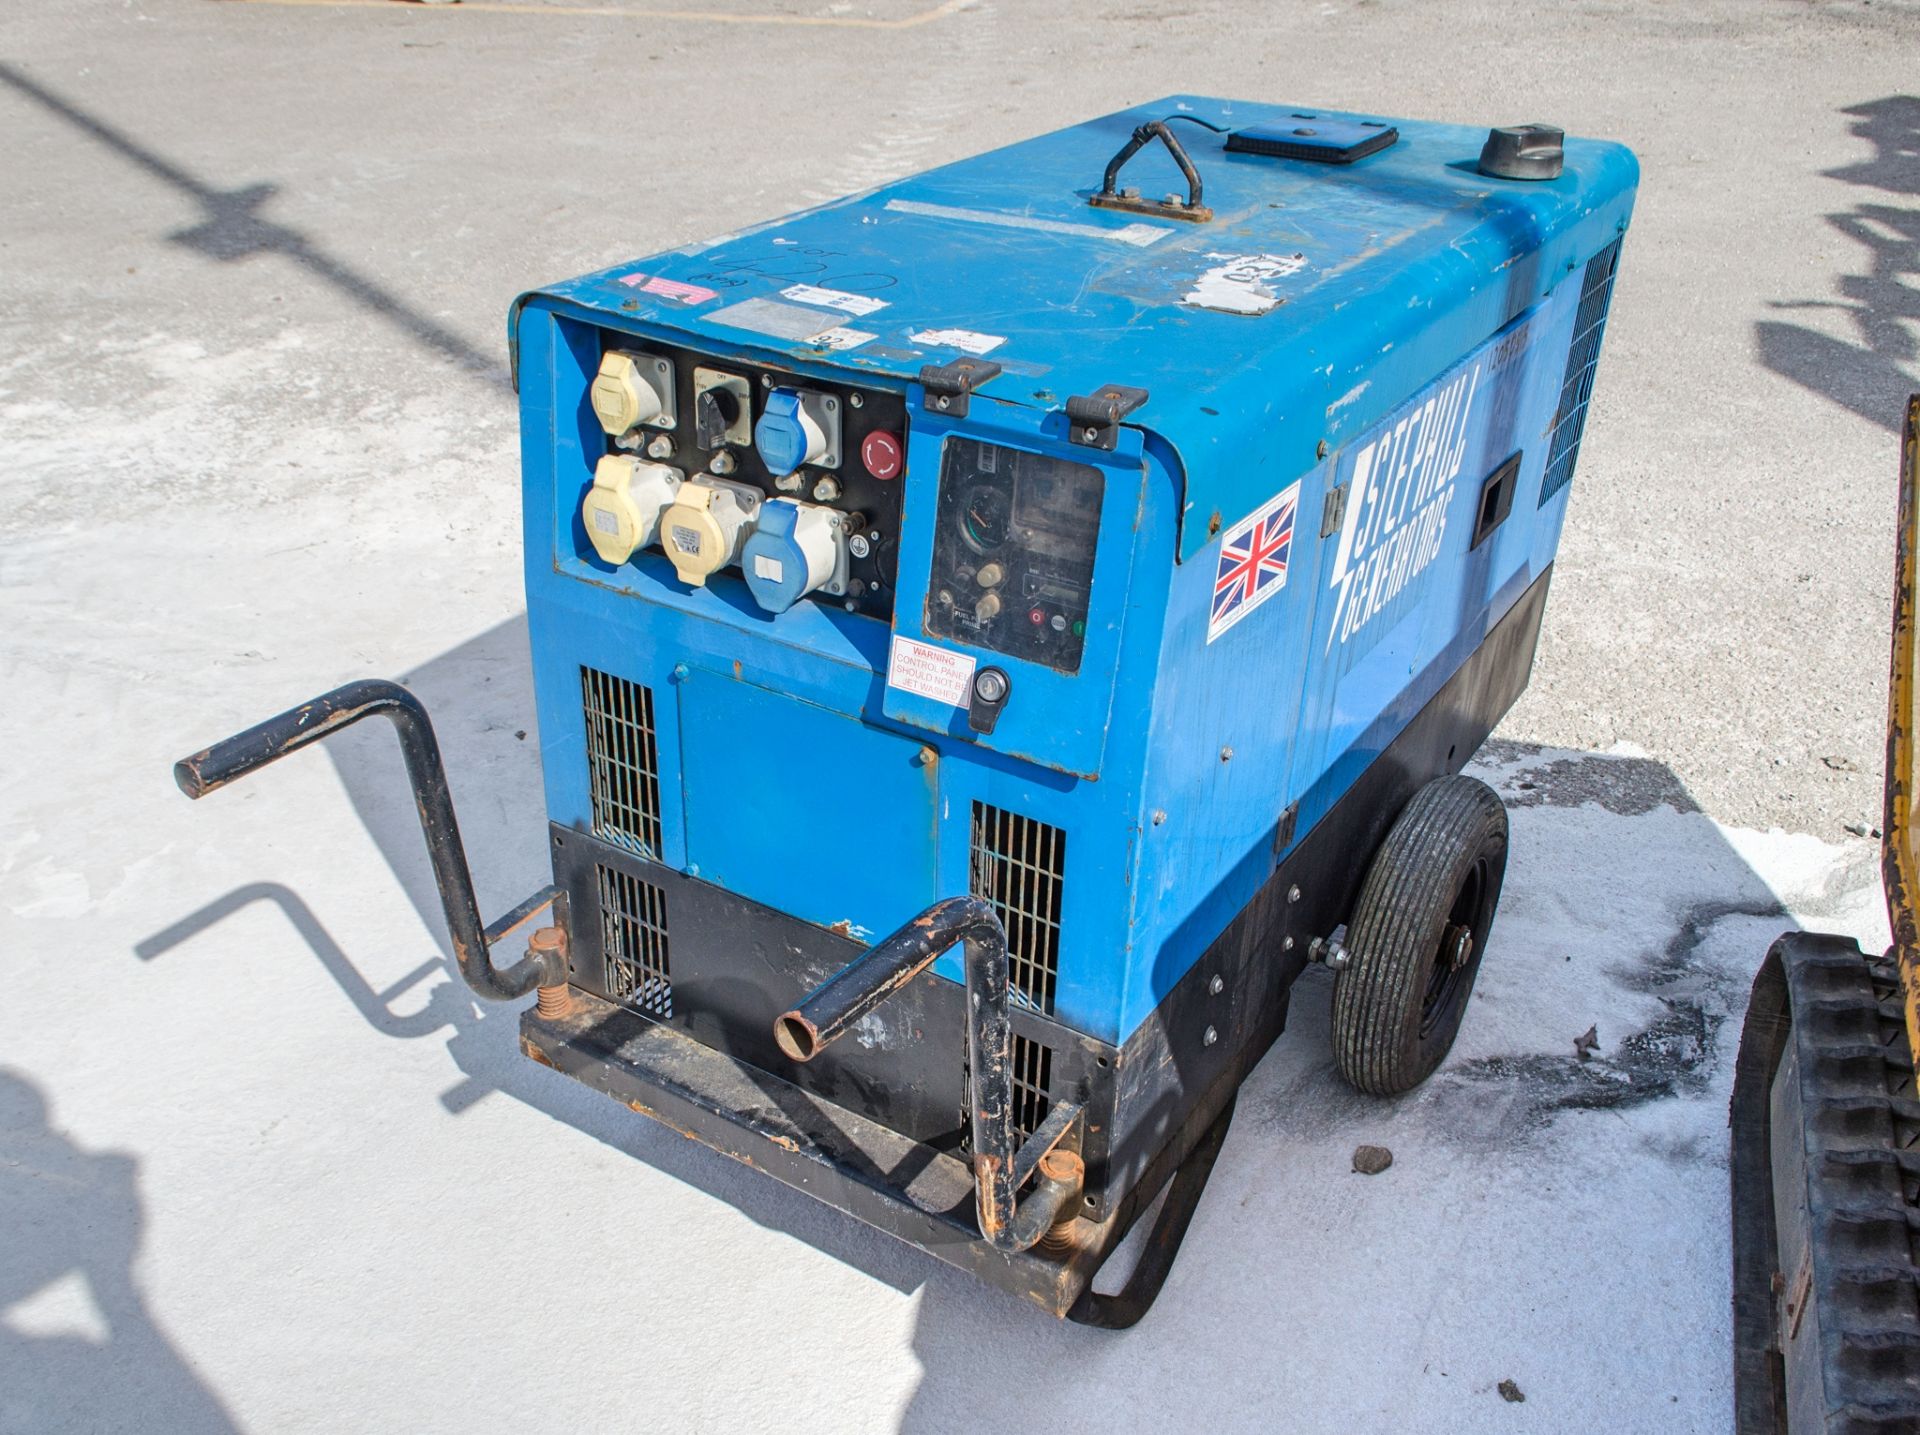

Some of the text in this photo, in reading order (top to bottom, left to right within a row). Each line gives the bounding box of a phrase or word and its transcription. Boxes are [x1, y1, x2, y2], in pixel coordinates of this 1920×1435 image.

[1354, 364, 1481, 560] STEPHILL
[1340, 483, 1455, 644] GENERATORS
[896, 653, 938, 673] CONTROL
[913, 646, 956, 666] WARNING
[896, 664, 968, 692] SHOULD NOT BE
[902, 678, 959, 701] JET WASHED
